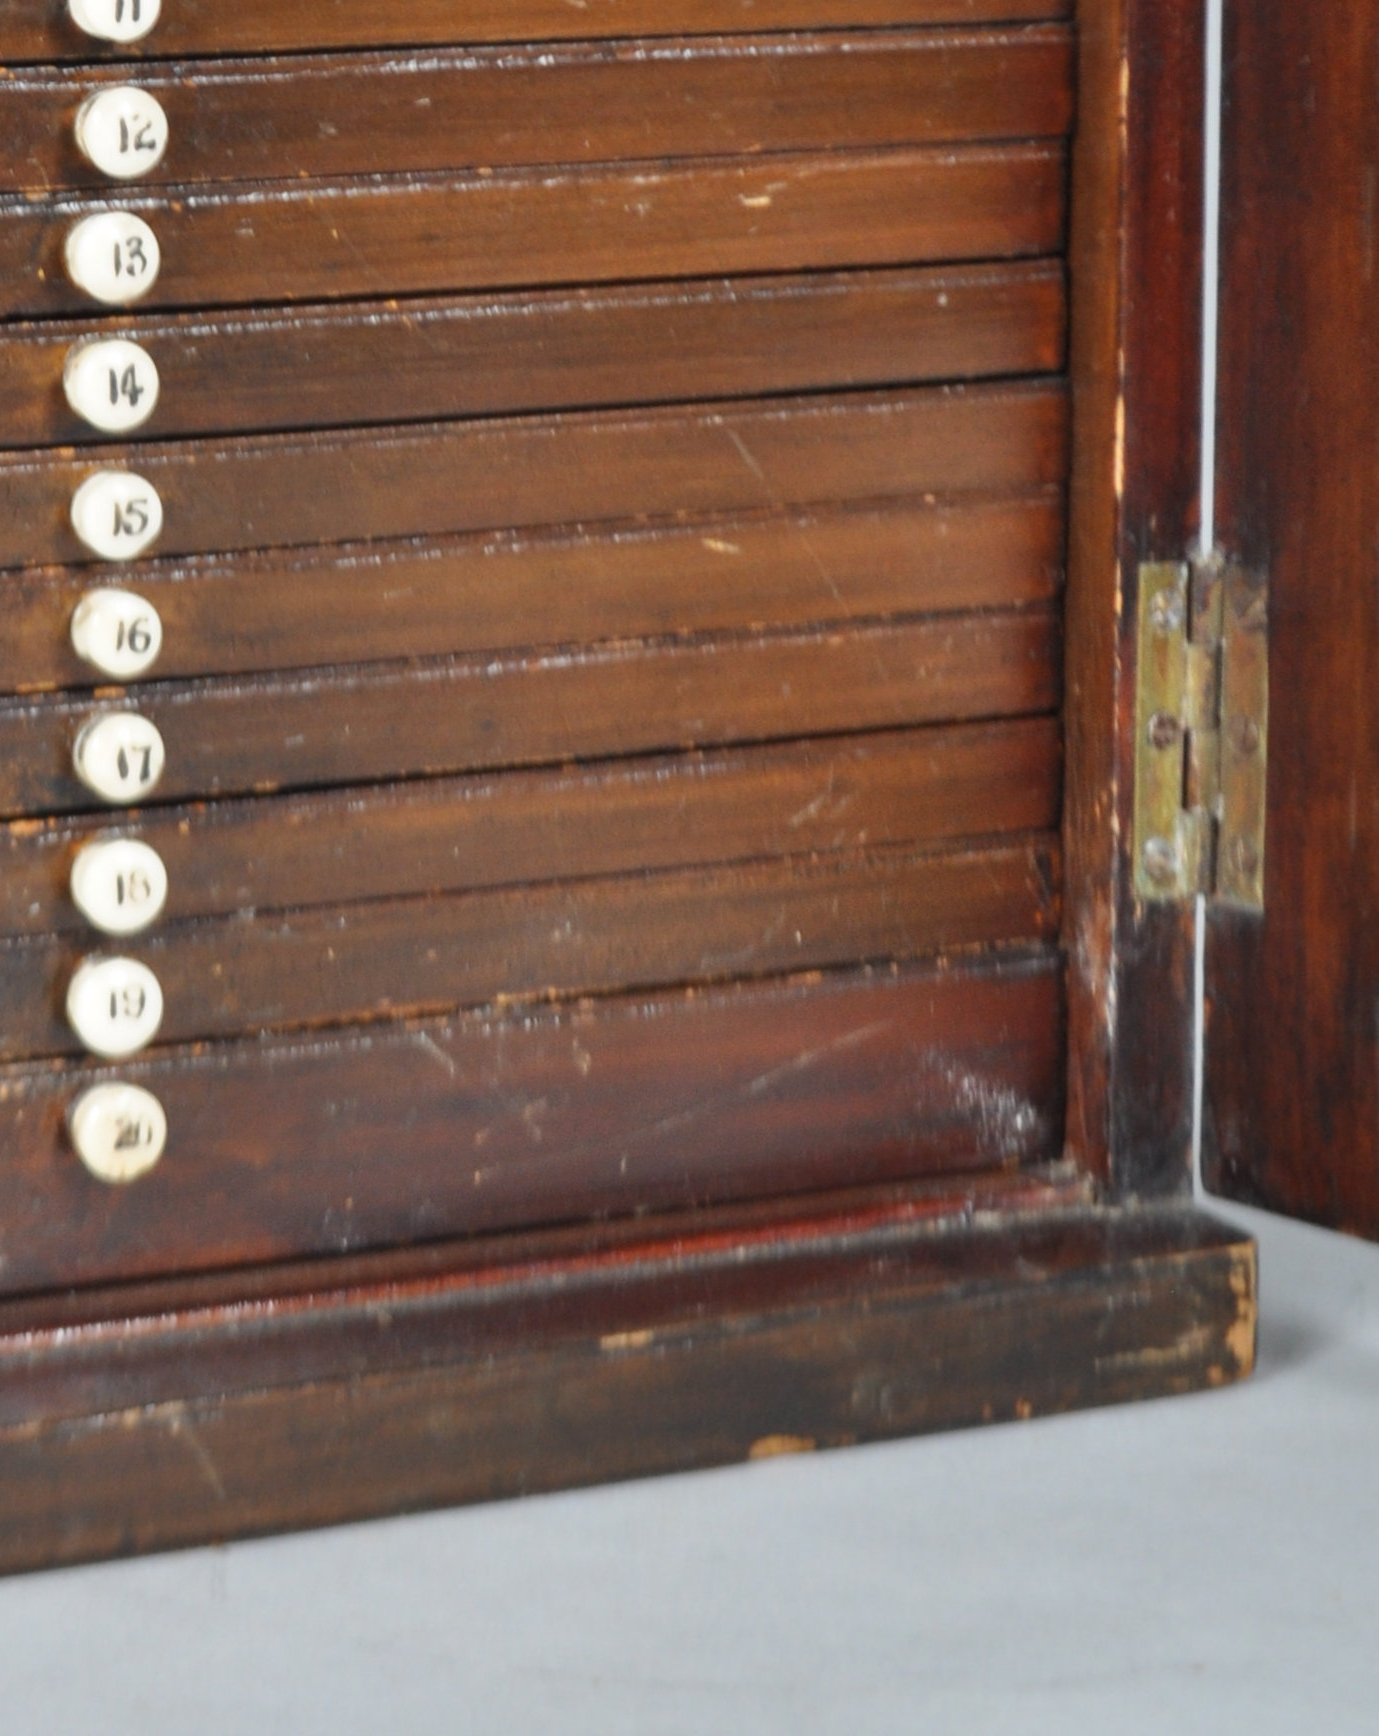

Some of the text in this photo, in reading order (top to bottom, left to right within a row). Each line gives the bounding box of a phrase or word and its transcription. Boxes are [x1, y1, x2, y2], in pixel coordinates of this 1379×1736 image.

[119, 115, 156, 153] 12
[114, 237, 148, 277] 13
[109, 366, 144, 406] 14
[112, 498, 148, 536] 15
[116, 617, 151, 653] 16
[117, 745, 152, 782] 17
[116, 872, 151, 904] 18
[110, 988, 145, 1021] 19
[114, 1112, 152, 1151] 20
